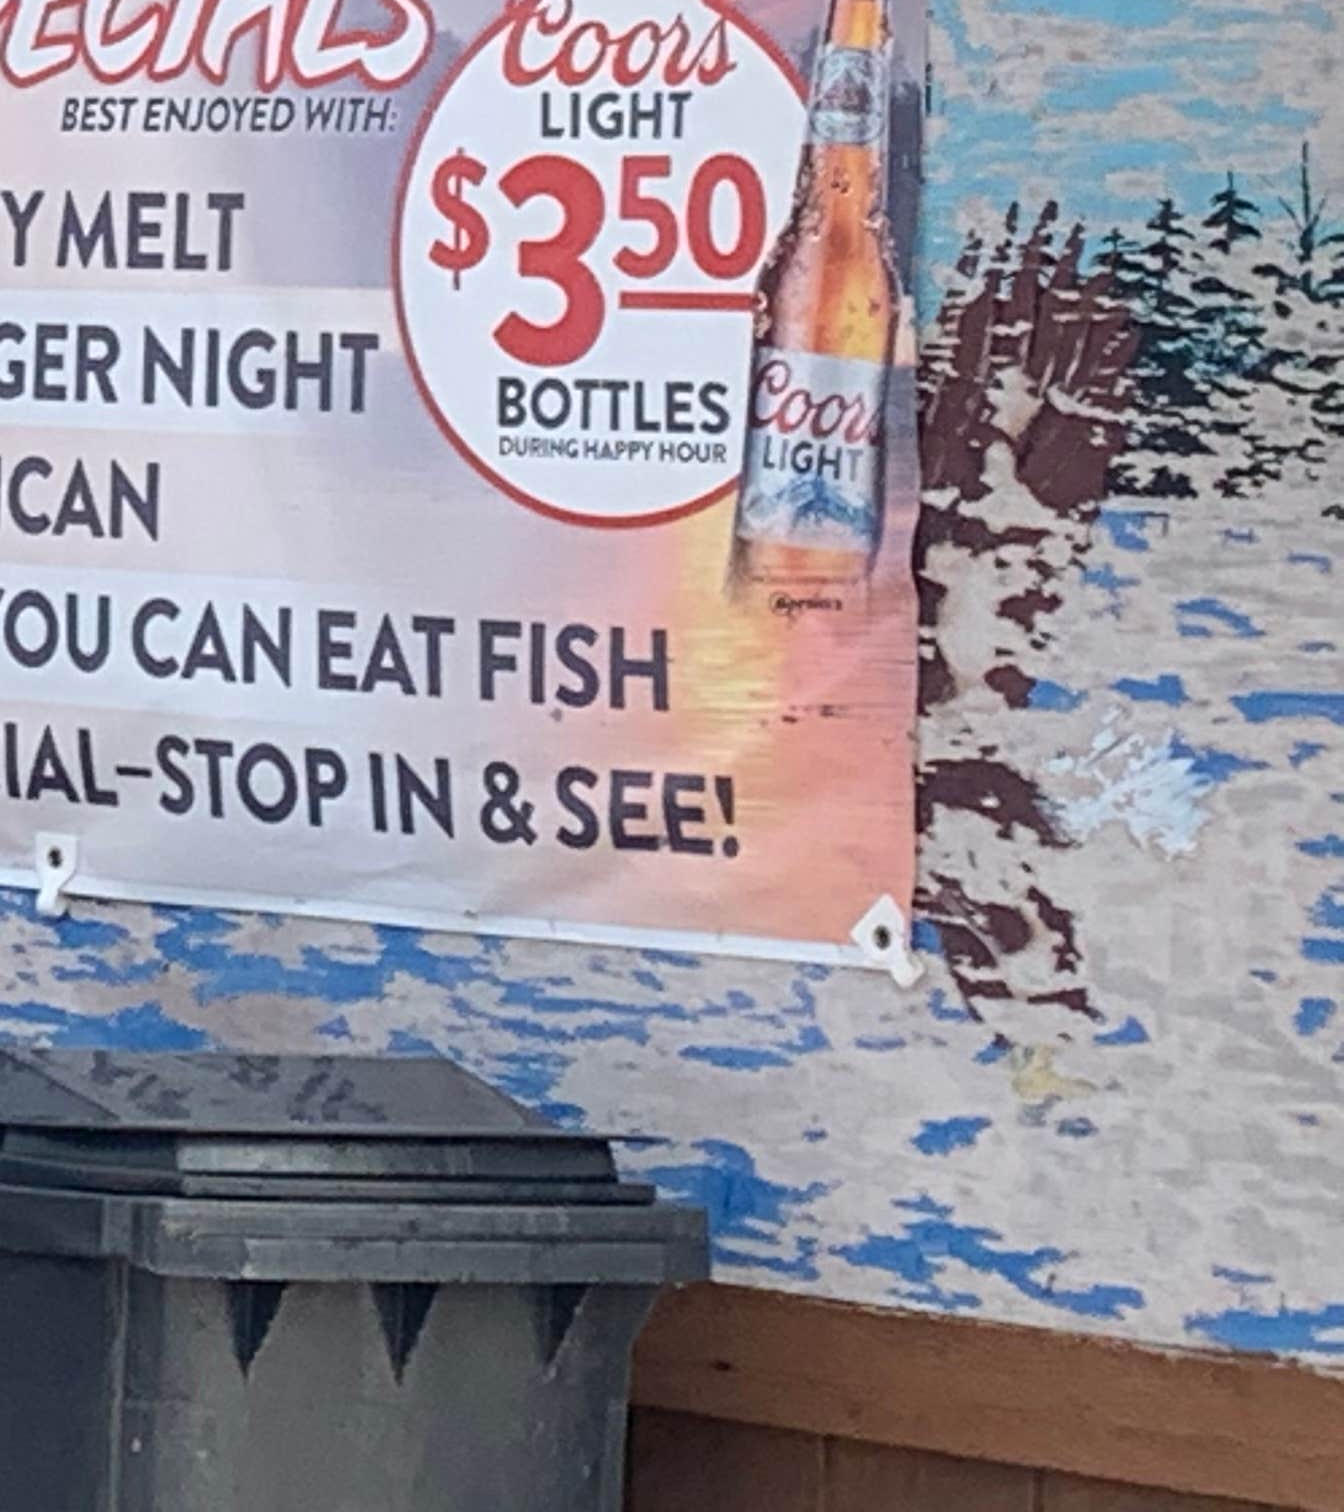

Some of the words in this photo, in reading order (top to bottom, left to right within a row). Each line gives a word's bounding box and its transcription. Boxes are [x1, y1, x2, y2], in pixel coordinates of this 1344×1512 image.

[60, 96, 139, 133] BEST
[142, 96, 294, 134] ENJOYED
[303, 98, 397, 134] WITH:
[540, 90, 692, 139] LIGHT
[54, 192, 245, 272] MELT
[141, 326, 379, 413] NIGHT
[496, 378, 731, 436] BOTTLES
[498, 436, 579, 460] DURING
[583, 438, 655, 463] HAPPY
[658, 440, 727, 465] HOUR
[763, 435, 864, 481] LIGHT
[131, 599, 295, 685] CAN
[318, 610, 457, 697] EAT
[479, 620, 670, 711] FISH
[368, 750, 454, 836] IN
[479, 761, 551, 845] &
[557, 765, 742, 858] SEE!
